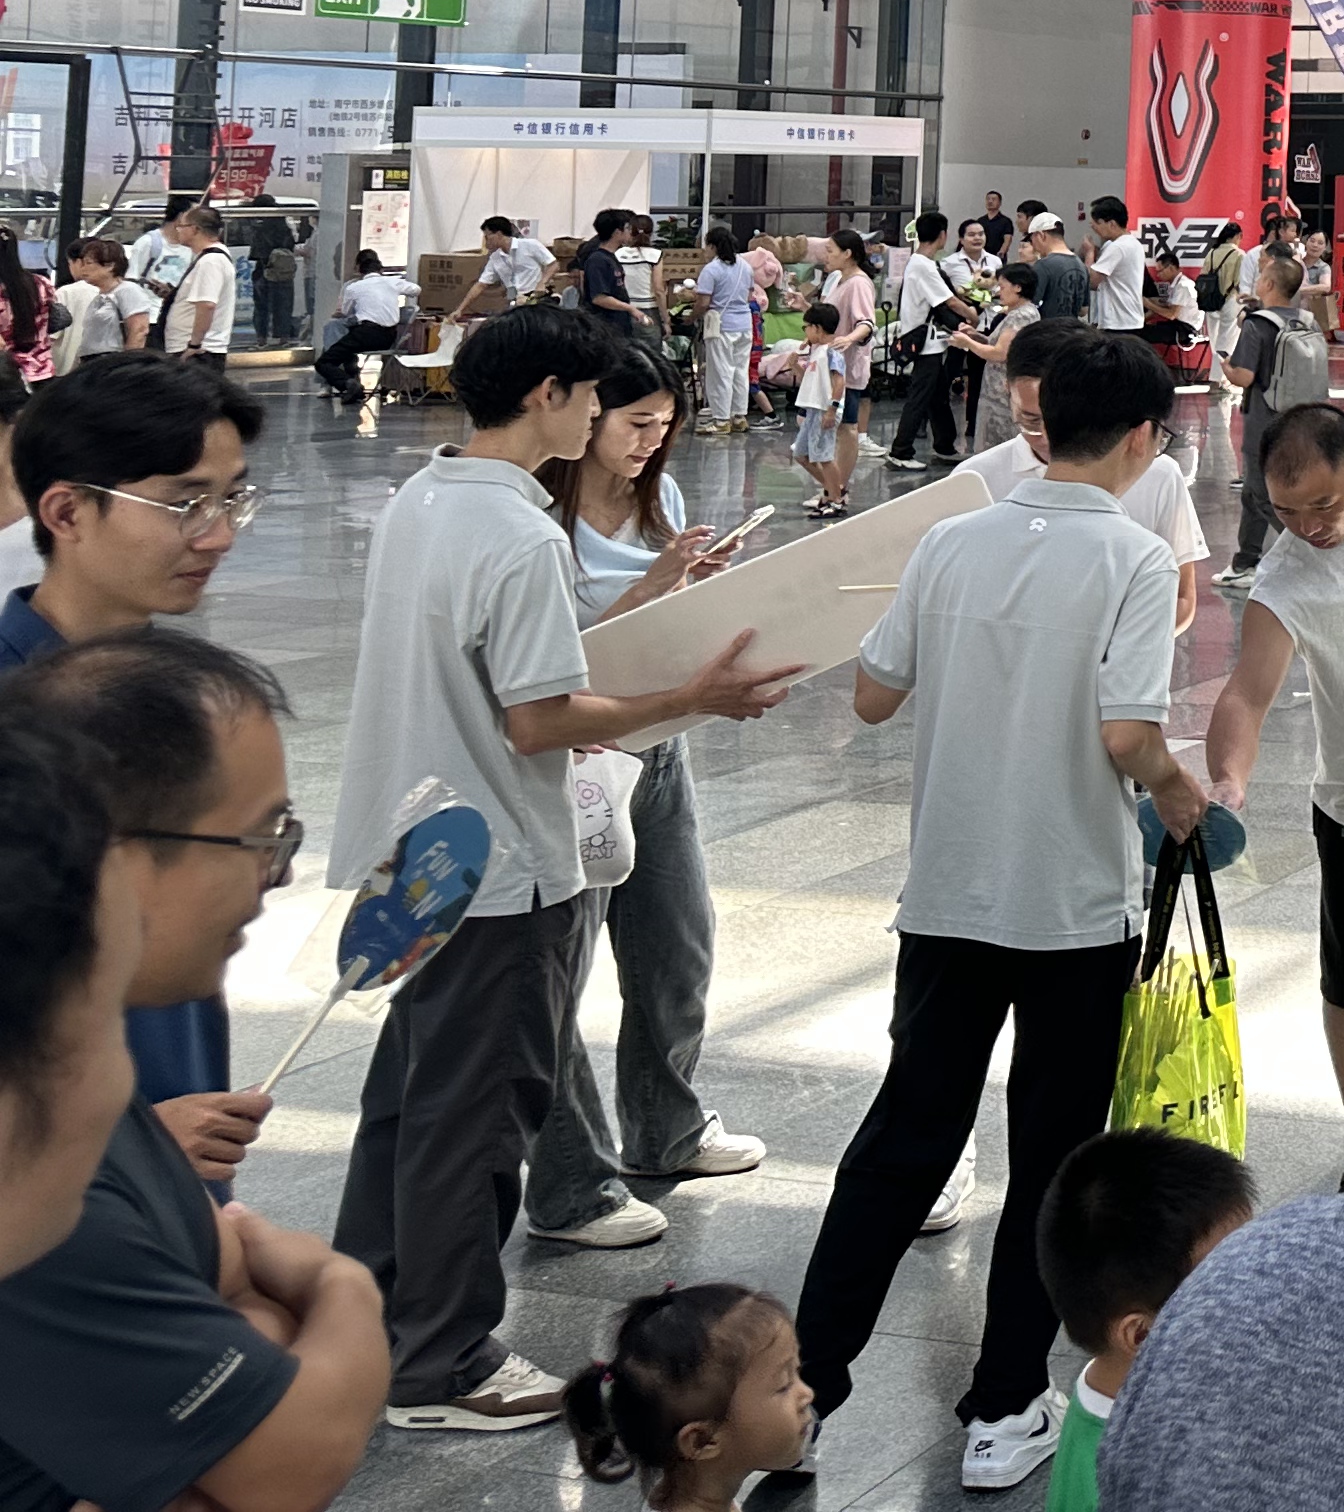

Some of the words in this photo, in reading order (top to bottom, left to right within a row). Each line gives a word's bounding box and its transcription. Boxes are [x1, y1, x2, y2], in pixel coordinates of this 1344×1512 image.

[1251, 2, 1278, 14] WAR
[1263, 48, 1287, 155] WAR
[513, 122, 609, 136] 中信银行信用卡
[786, 127, 855, 141] 中信银行信用卡
[201, 1346, 238, 1386] SPACE
